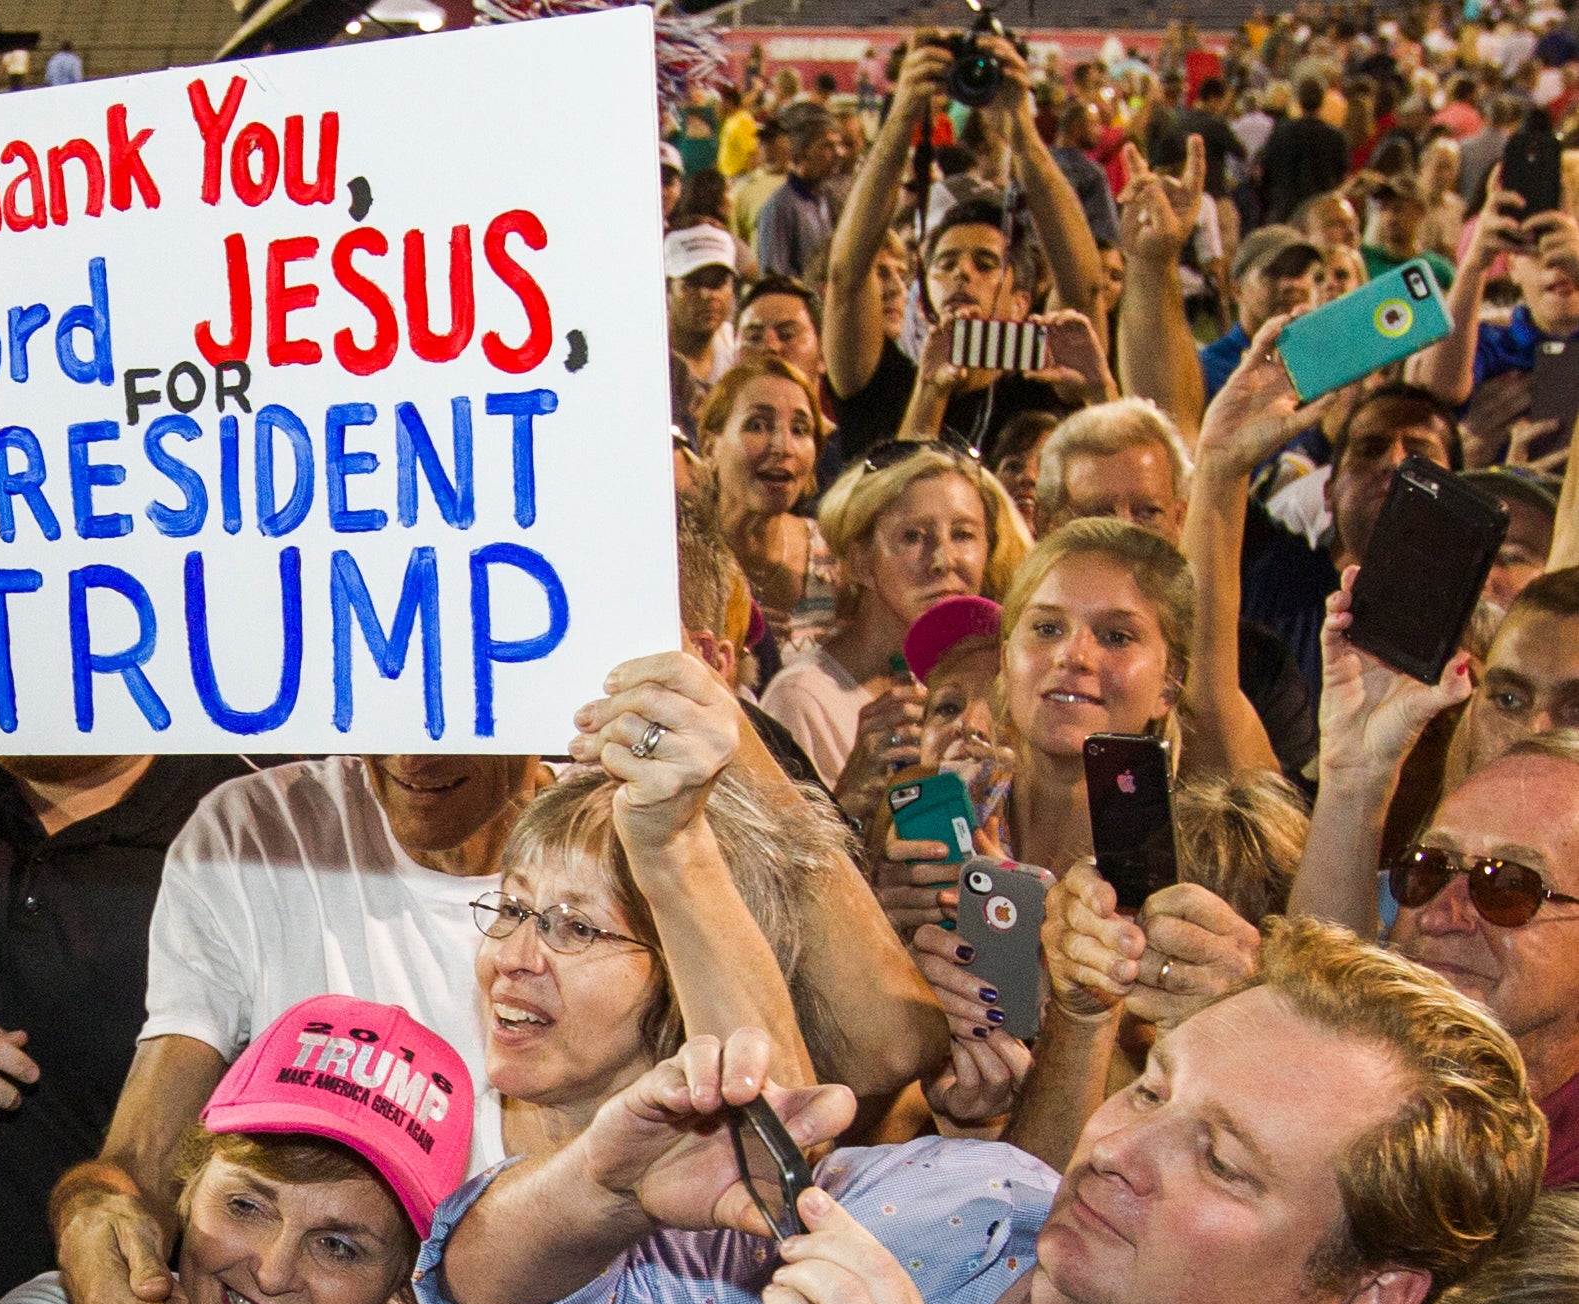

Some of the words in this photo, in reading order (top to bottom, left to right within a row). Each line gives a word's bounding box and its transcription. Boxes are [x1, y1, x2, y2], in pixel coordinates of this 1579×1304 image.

[186, 74, 374, 222] You,
[194, 209, 589, 377] JESUS,
[123, 360, 253, 425] FOR
[275, 1067, 315, 1086] MAKE
[312, 1076, 371, 1106] AMERICA
[371, 1092, 408, 1128] GREAT
[404, 1117, 436, 1156] AGAIN
[292, 1031, 450, 1124] TRUMP
